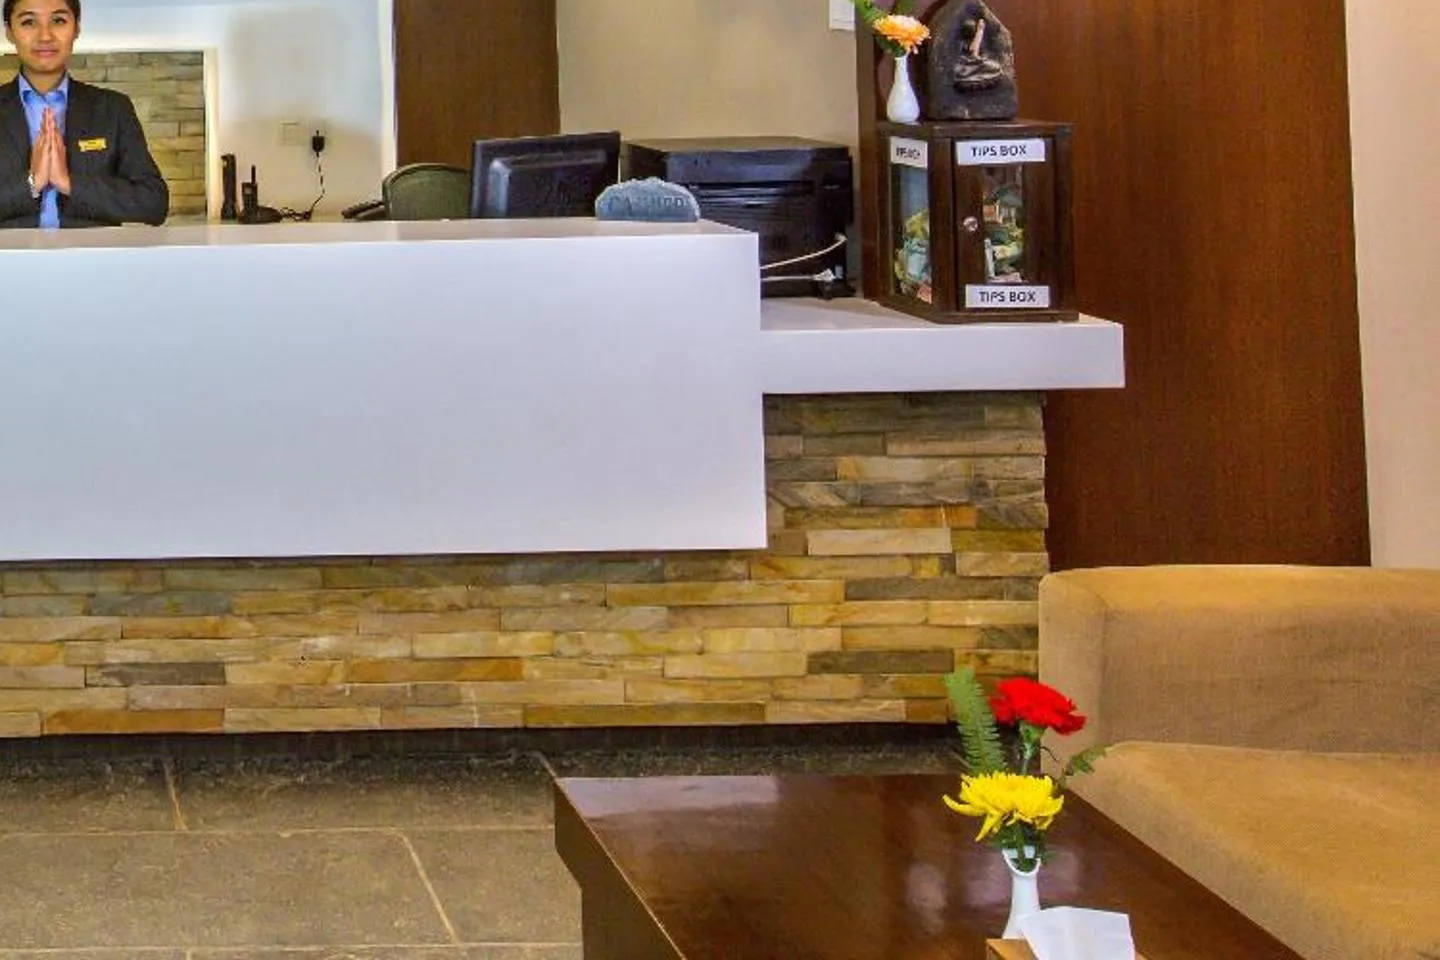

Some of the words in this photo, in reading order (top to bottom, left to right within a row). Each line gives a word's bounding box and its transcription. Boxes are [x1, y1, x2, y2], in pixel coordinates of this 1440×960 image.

[971, 144, 998, 158] TIPS
[1000, 144, 1027, 157] BOX
[979, 290, 1006, 303] TIPS
[1009, 290, 1037, 303] BOX
